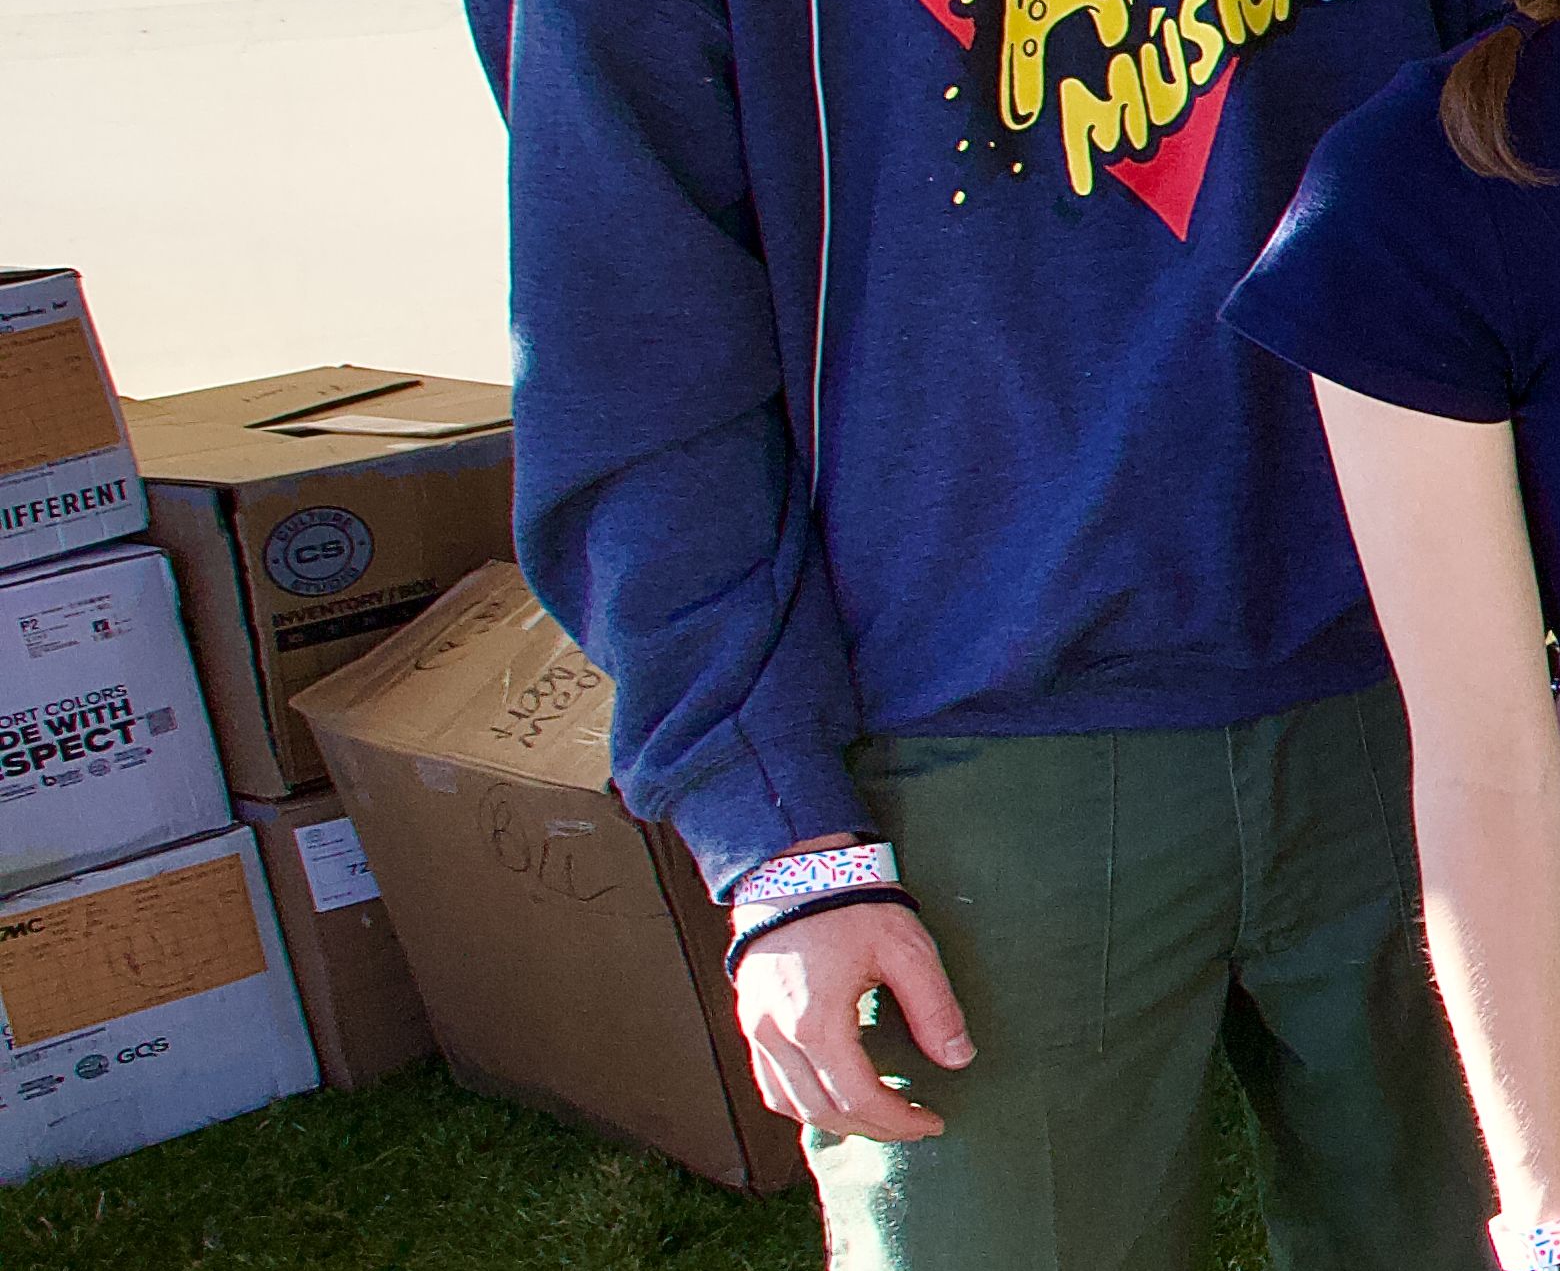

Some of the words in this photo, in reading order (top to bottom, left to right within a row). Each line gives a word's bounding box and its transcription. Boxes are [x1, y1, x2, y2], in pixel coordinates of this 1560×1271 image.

[0, 479, 127, 530] IFFERENT
[295, 539, 346, 564] CS
[44, 697, 133, 737] WITH
[45, 683, 128, 716] COLORS
[0, 718, 136, 780] SPECT
